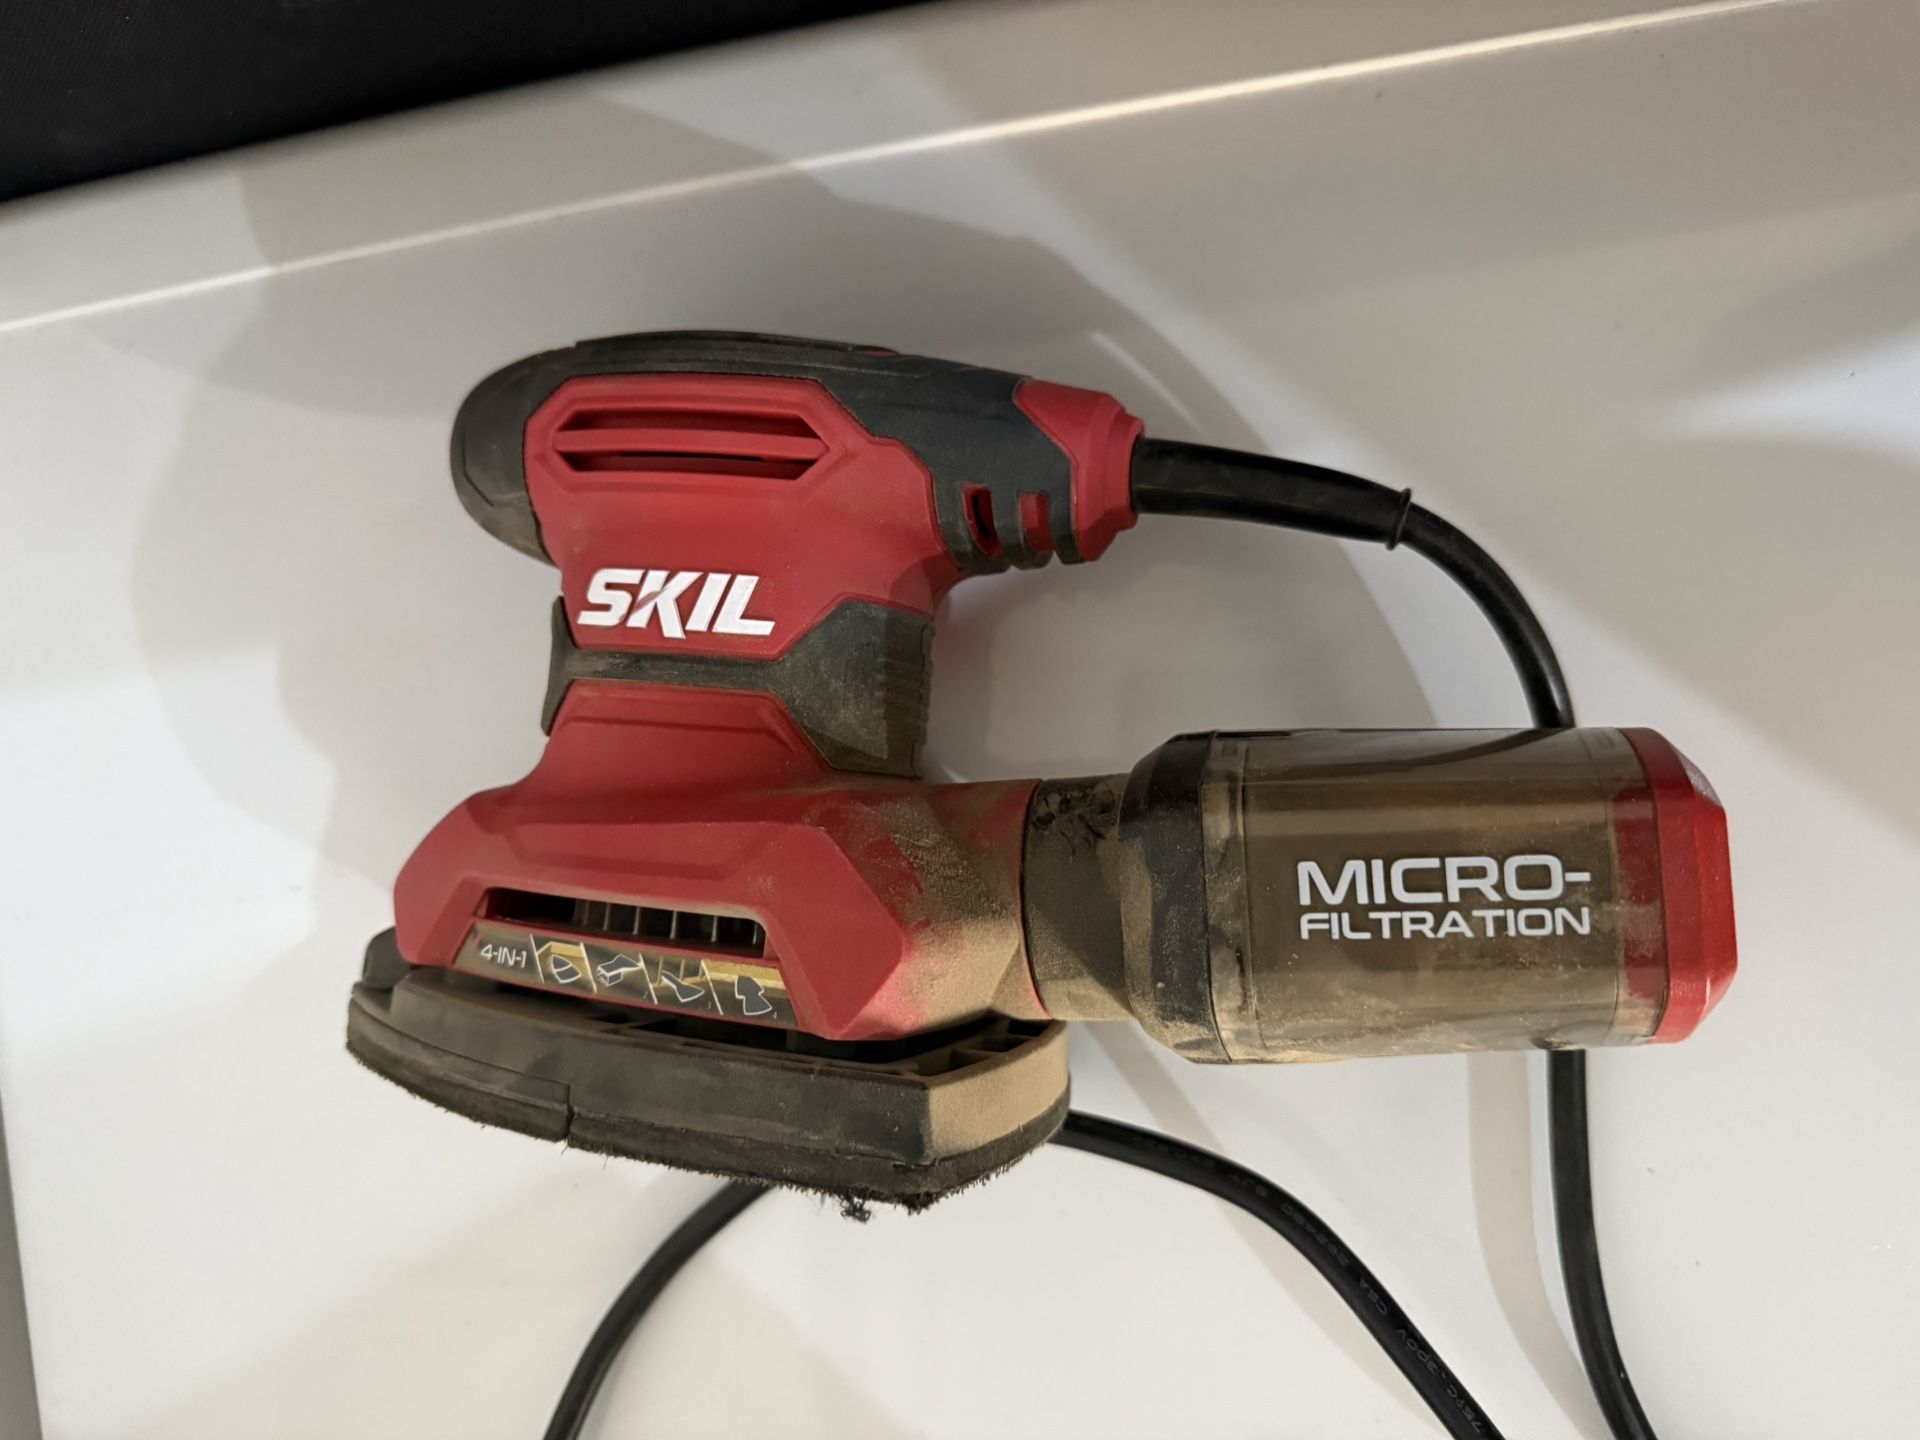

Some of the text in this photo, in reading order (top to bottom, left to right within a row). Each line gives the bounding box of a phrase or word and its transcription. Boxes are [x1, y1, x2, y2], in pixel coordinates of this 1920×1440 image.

[577, 568, 776, 640] SKIL
[1297, 854, 1591, 905] MICRO-
[1300, 907, 1591, 940] FILTRATION
[480, 943, 528, 969] 4-IN-1
